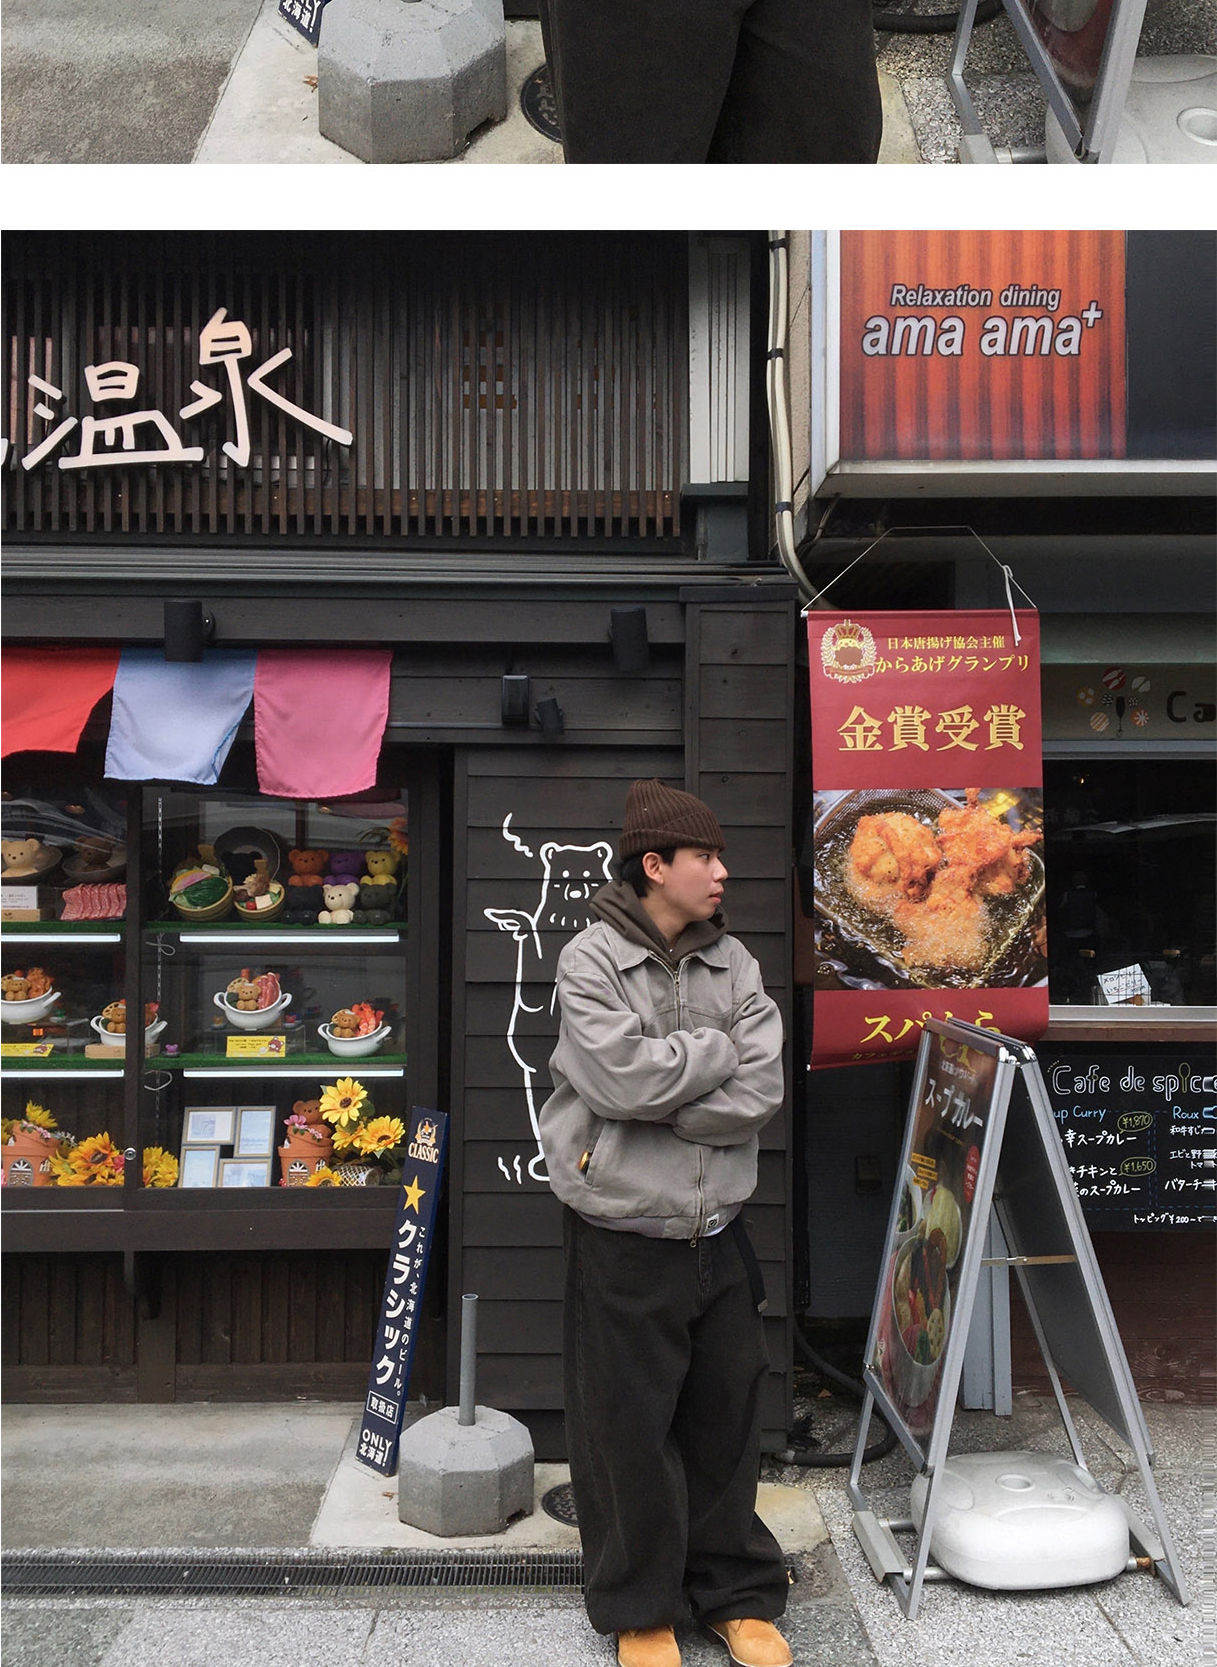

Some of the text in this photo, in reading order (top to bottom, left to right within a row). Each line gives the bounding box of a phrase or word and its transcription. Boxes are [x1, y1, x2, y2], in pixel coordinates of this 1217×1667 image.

[890, 283, 1062, 311] Relaxation dining
[862, 314, 966, 357] ama
[1, 307, 354, 471] 温泉
[887, 635, 1006, 650] 日本唐揚げ協会主催
[875, 654, 1029, 674] からあげグランプリ
[837, 704, 1026, 752] 金賞受賞
[860, 1010, 1001, 1044] スパら
[1052, 1065, 1110, 1095] Cafe
[1120, 1066, 1146, 1092] de
[925, 1078, 983, 1130] スープカレー
[1053, 1105, 1106, 1124] up Curry
[1173, 1105, 1199, 1119] Roux
[1060, 1129, 1137, 1148] 幸スープカレー
[408, 1142, 439, 1164] CLASSIC
[376, 1219, 417, 1385] クラシック
[370, 1396, 394, 1419] 取扱店
[362, 1428, 392, 1451] ONLY
